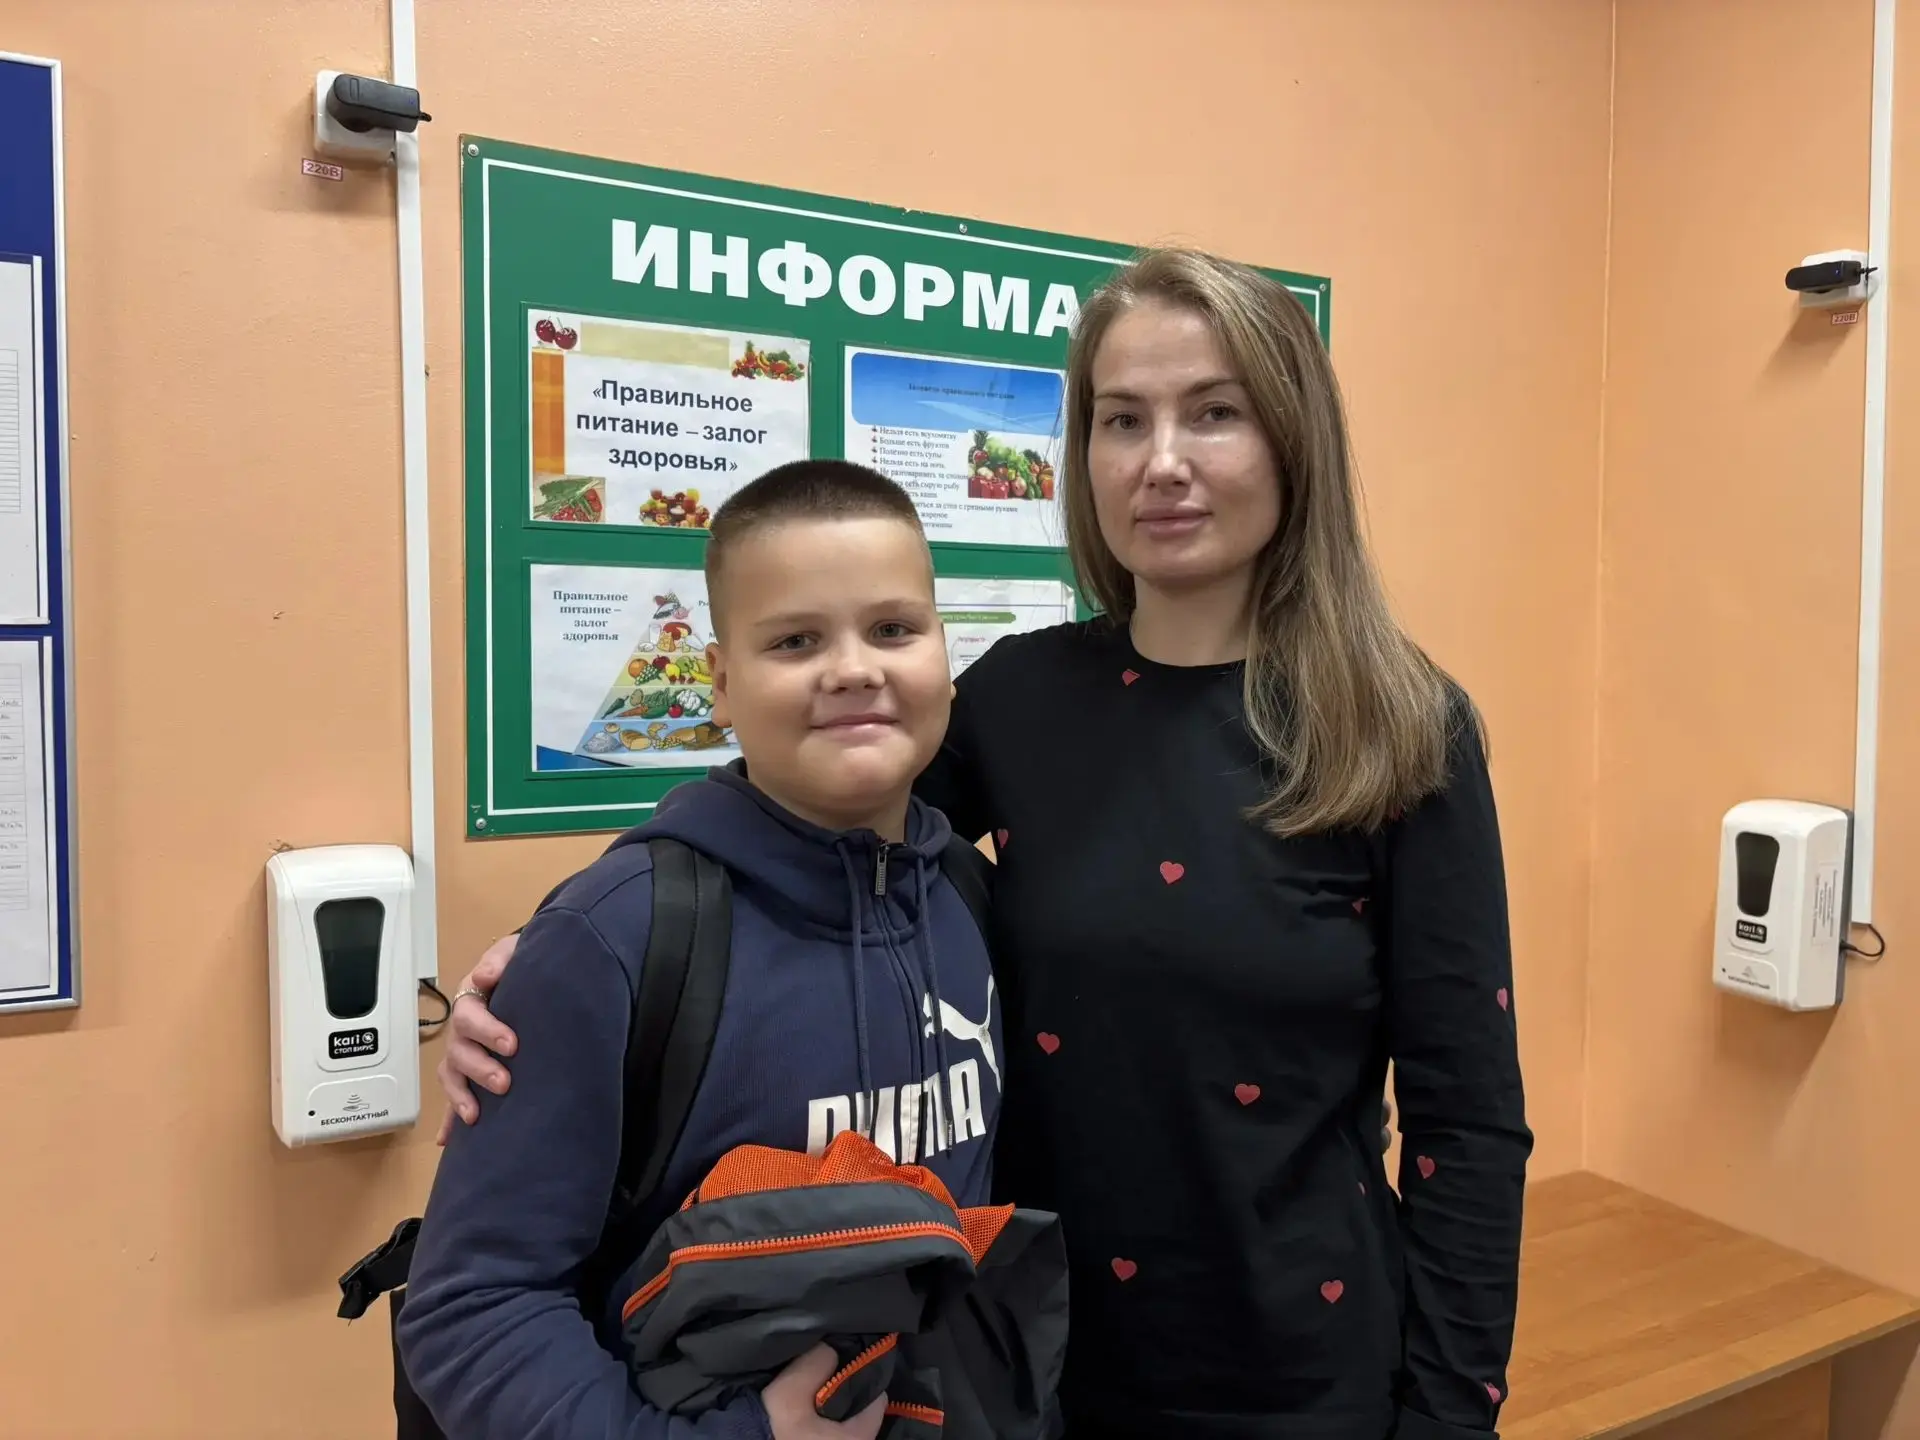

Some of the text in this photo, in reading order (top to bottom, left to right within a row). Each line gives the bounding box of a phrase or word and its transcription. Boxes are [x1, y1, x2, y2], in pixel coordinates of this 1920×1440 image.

[307, 162, 339, 177] 220В
[611, 218, 1080, 338] ИНФОРМА
[592, 379, 753, 413] «Правильное
[576, 414, 679, 437] питание
[702, 425, 768, 444] залог
[879, 427, 957, 441] Нельзя есть всухомятку
[879, 437, 905, 446] Больше
[879, 447, 908, 456] Полезно
[924, 451, 942, 459] супы
[608, 448, 738, 472] здоровья»
[879, 457, 903, 466] Нельзя
[553, 590, 628, 602] Правильное
[560, 605, 612, 614] питание
[574, 619, 608, 628] залог
[562, 632, 619, 643] здоровья
[333, 1034, 360, 1047] kari
[334, 1046, 353, 1055] СТОП
[321, 1109, 389, 1126] БЕСКОНТАКТНЫЙ
